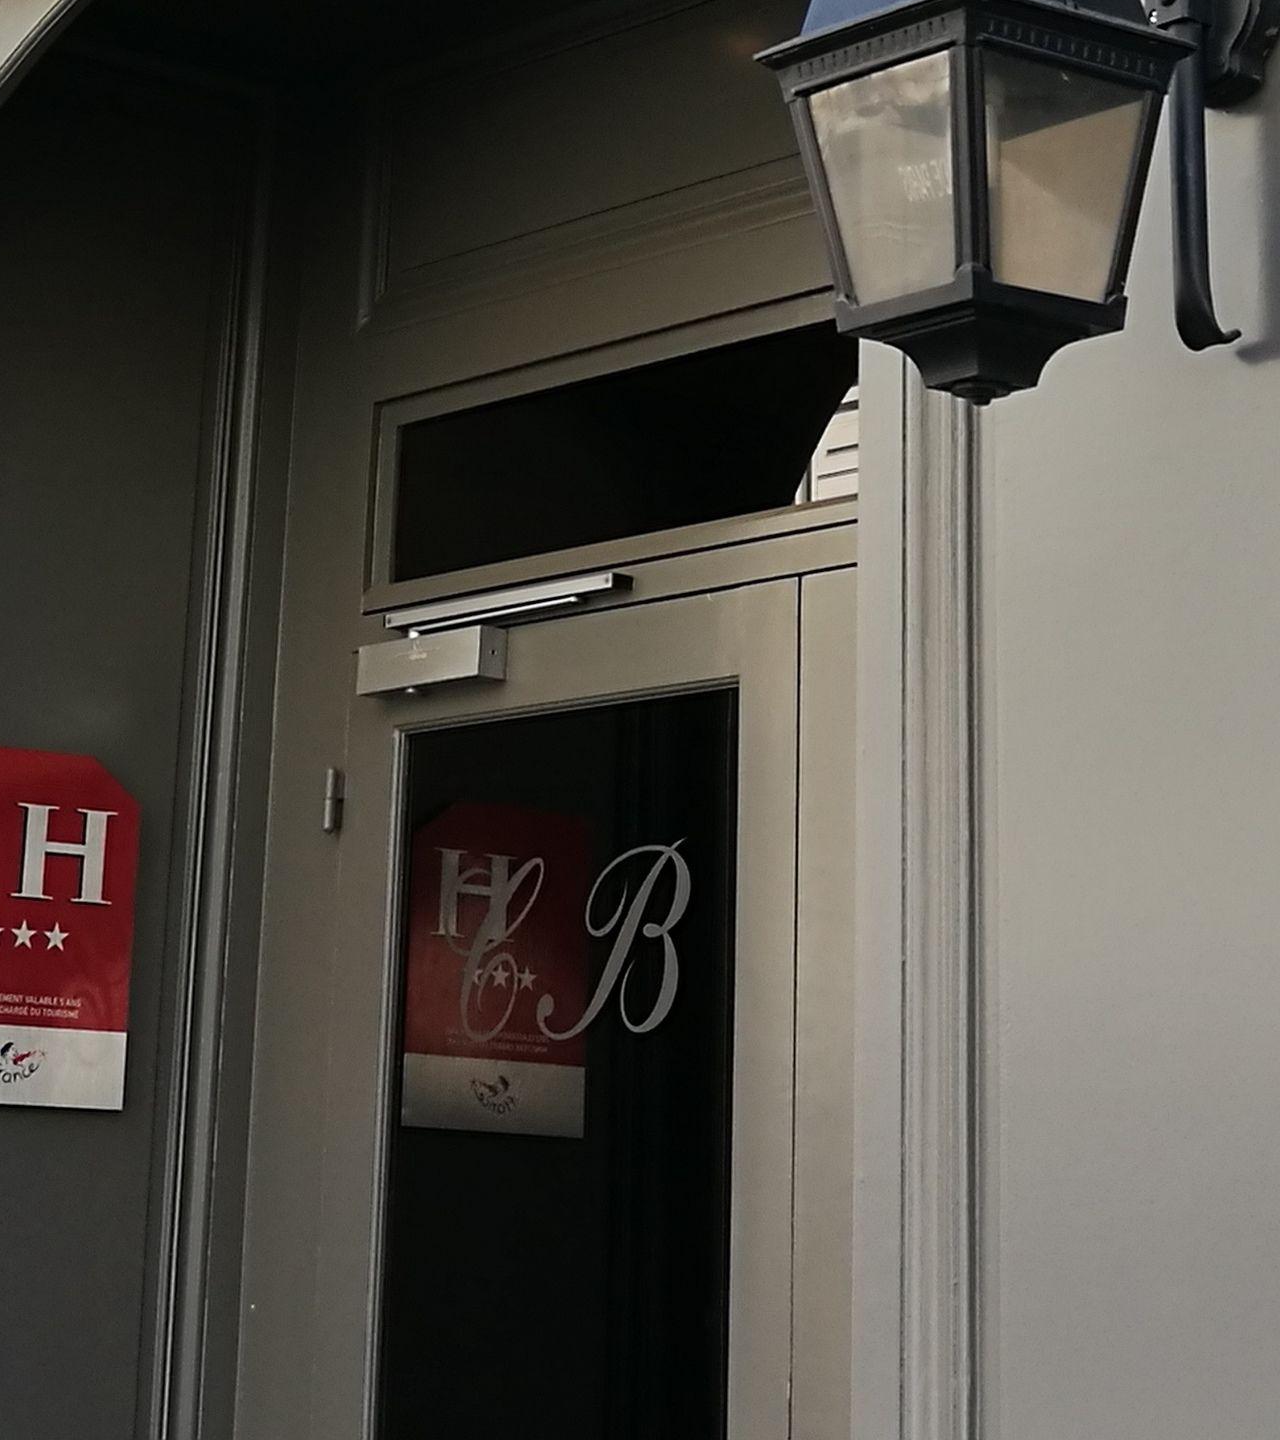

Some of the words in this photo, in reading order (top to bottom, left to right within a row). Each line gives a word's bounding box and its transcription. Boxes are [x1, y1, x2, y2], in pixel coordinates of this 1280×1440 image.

[10, 801, 119, 906] H
[25, 995, 58, 1006] VALABLE
[30, 1007, 41, 1016] DU
[42, 1008, 80, 1020] TOURISME
